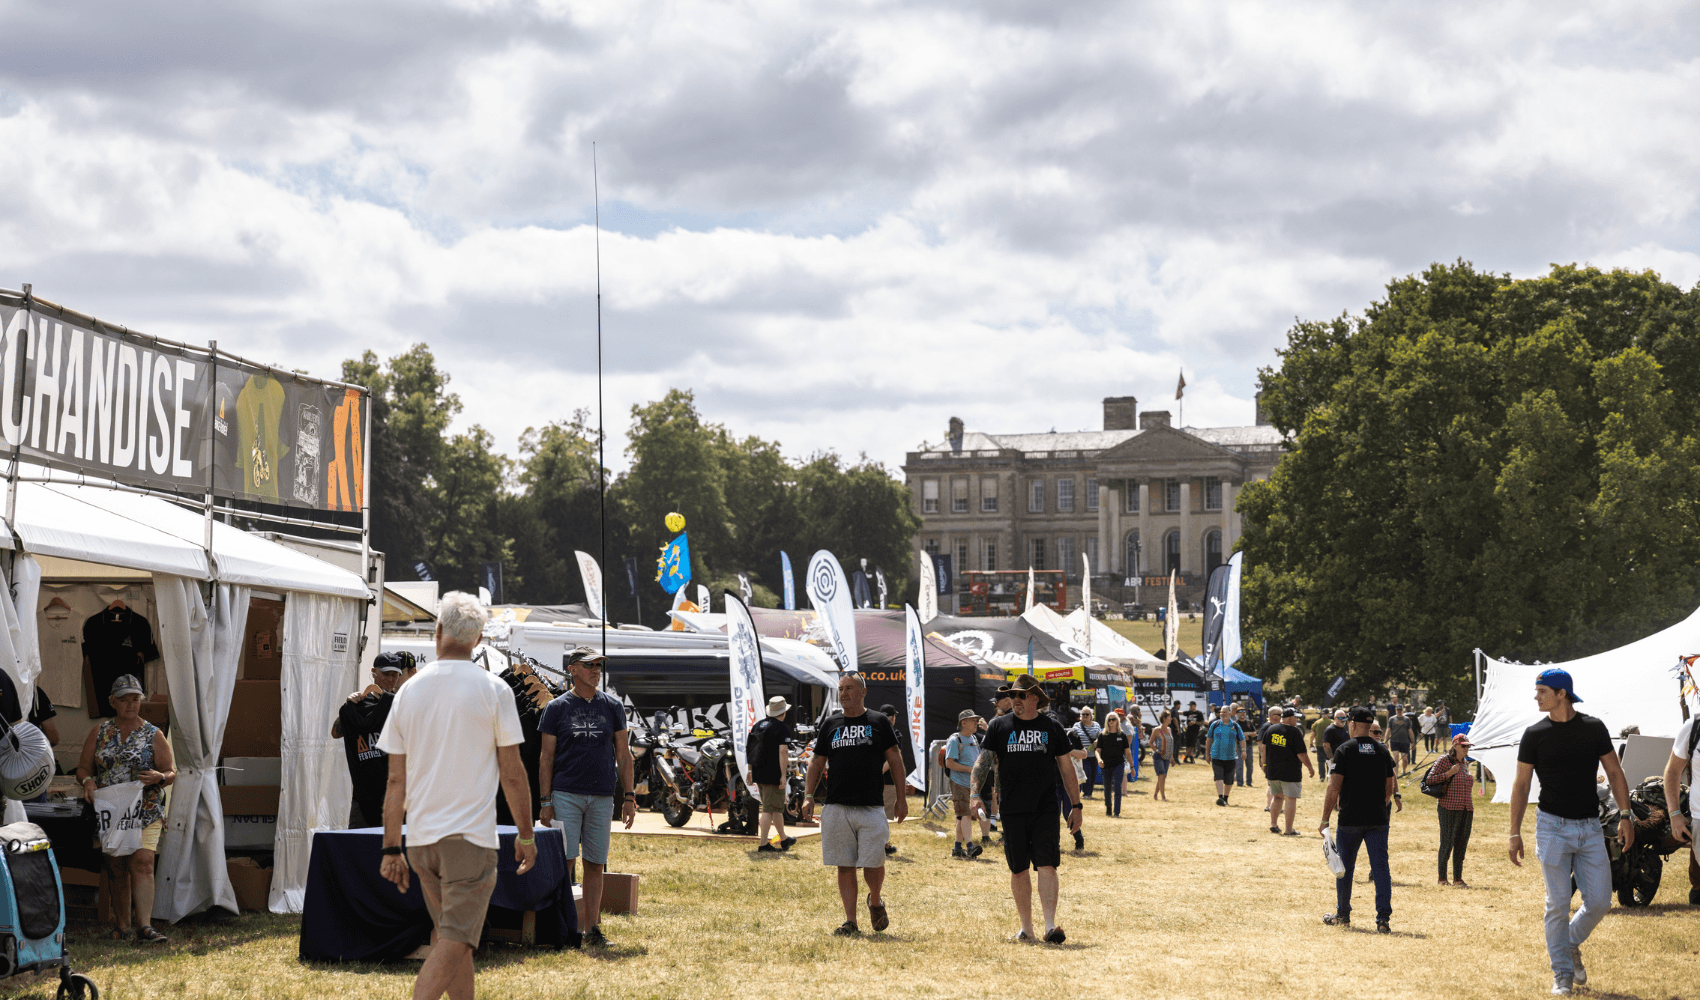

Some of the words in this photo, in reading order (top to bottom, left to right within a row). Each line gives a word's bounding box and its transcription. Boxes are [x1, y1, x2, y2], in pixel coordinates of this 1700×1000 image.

[0, 308, 196, 478] CHANDISE
[1124, 576, 1143, 587] ABR
[1145, 576, 1187, 586] FESTIAL
[334, 636, 347, 644] FIELD
[841, 725, 865, 739] ABR
[1017, 729, 1042, 744] ABR
[831, 738, 856, 750] FESTIVAL
[1007, 743, 1033, 753] FESTIVAL
[357, 749, 382, 762] FESTIVAL
[20, 768, 49, 794] SHOEI
[233, 814, 276, 824] GILDAN
